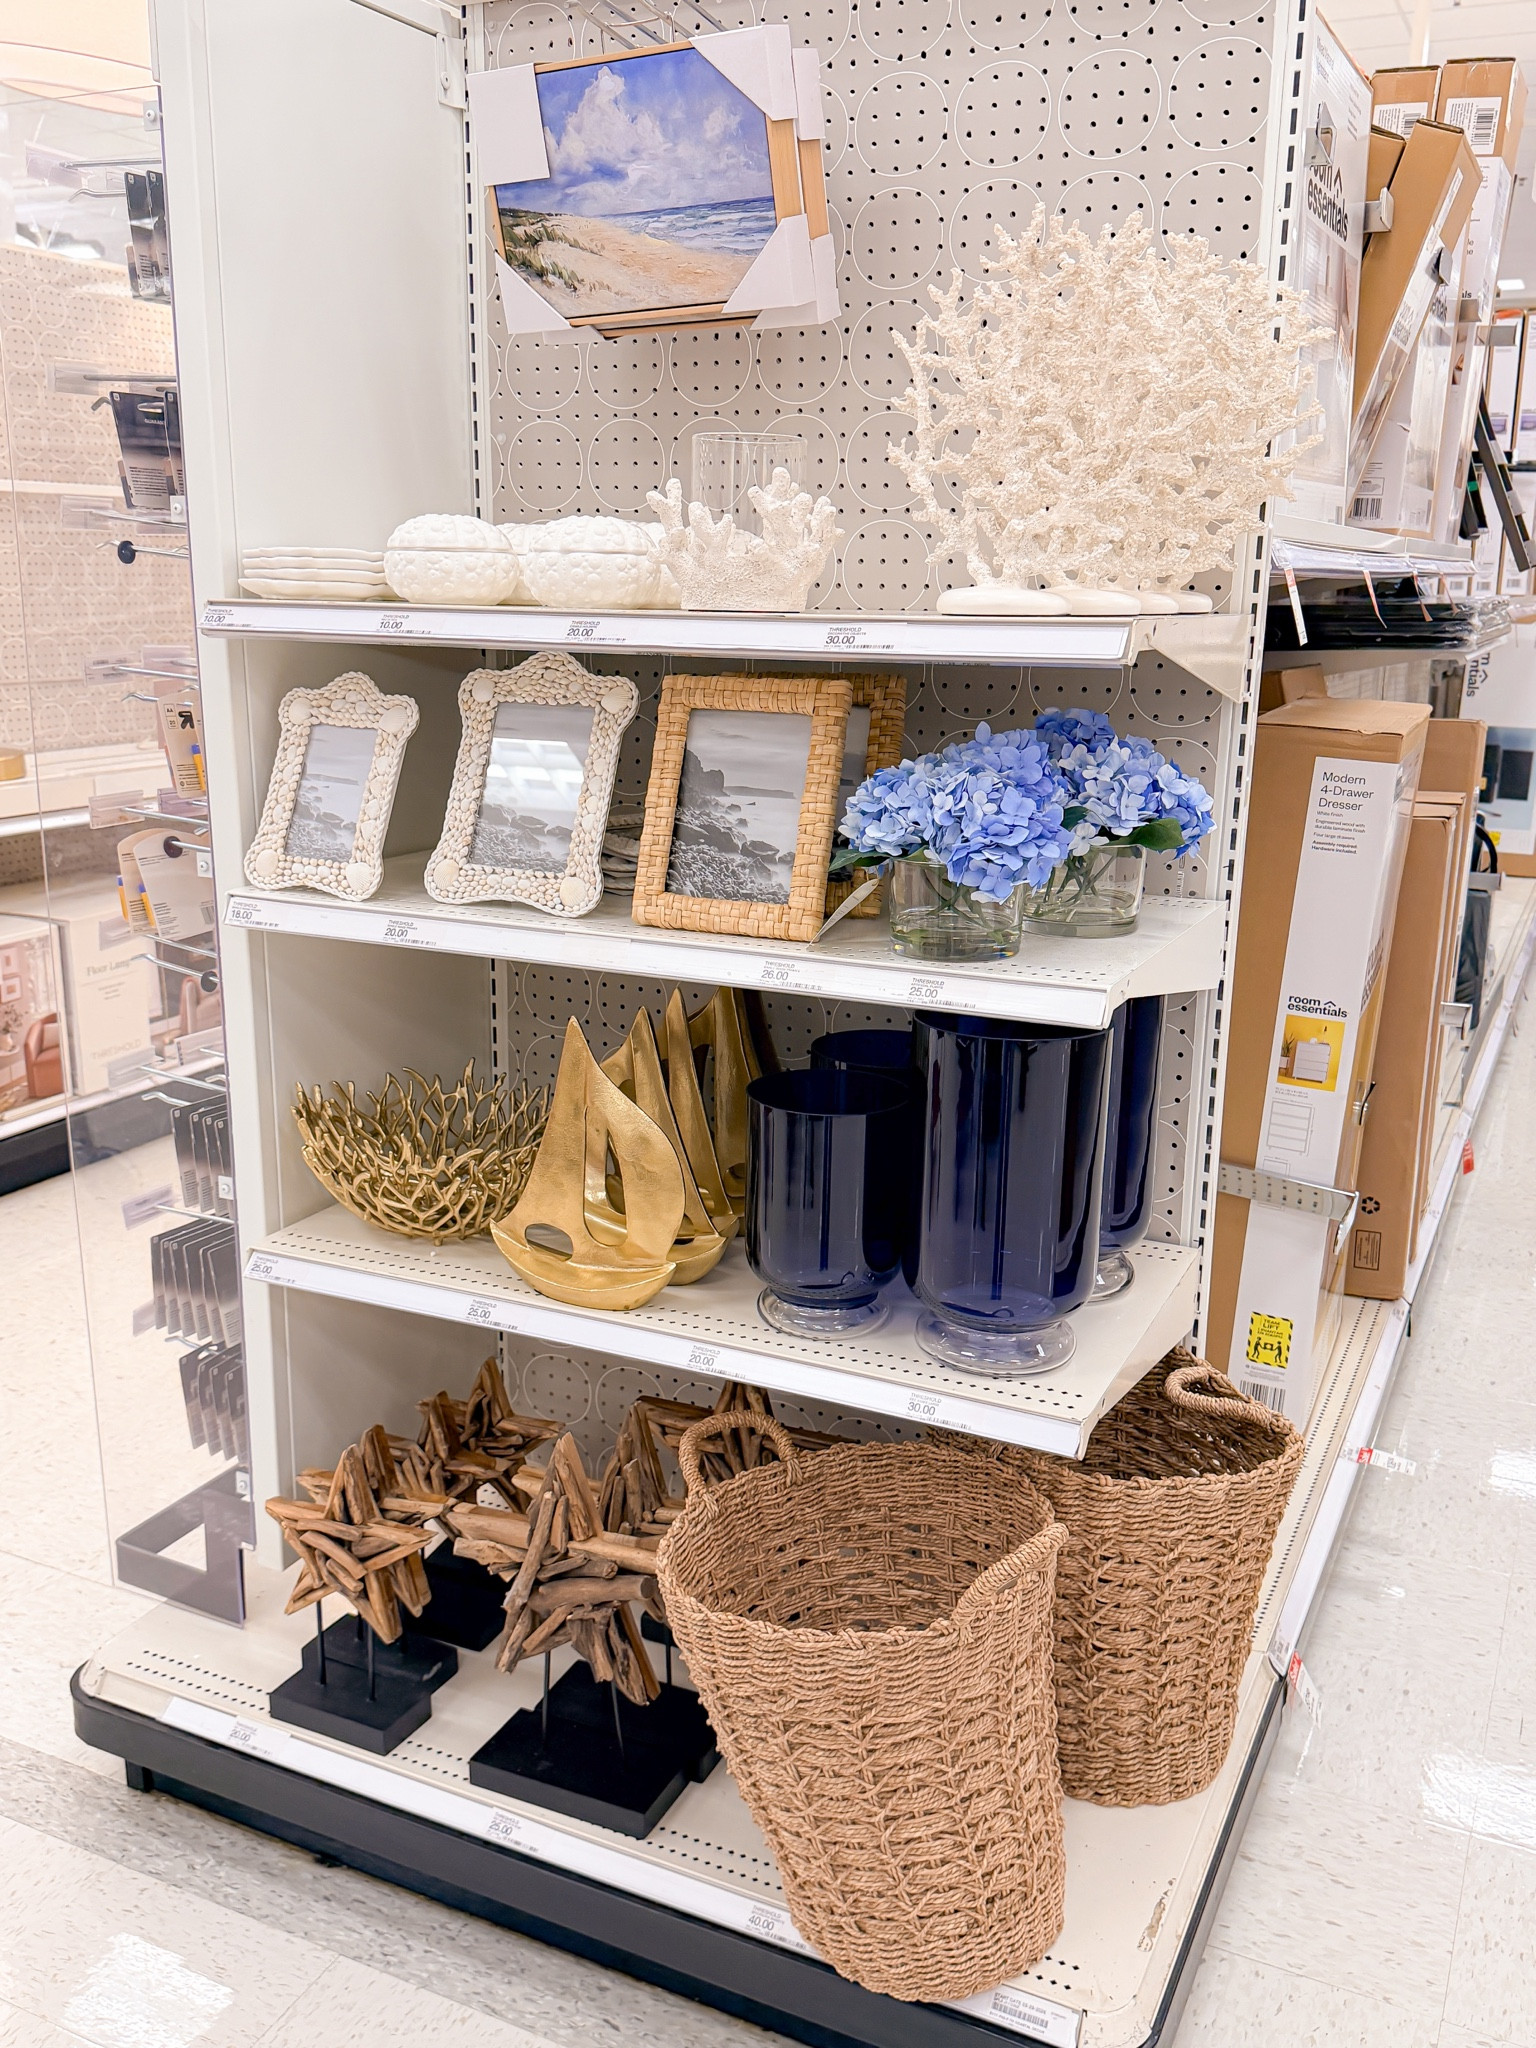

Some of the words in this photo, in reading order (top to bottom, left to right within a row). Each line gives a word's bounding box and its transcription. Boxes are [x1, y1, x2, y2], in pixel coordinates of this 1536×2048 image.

[1308, 178, 1348, 242] essentials
[204, 615, 226, 623] 10.00
[380, 621, 403, 629] 10.00
[567, 628, 594, 637] 20.00
[826, 636, 856, 645] 30.00
[1466, 659, 1482, 697] ntials
[1322, 771, 1366, 785] Modern
[1320, 785, 1374, 799] 4-Drawer
[1318, 797, 1363, 811] Dresser
[1315, 819, 1341, 827] Engineered
[231, 910, 253, 920] 18.00
[384, 927, 408, 938] 20.00
[765, 960, 795, 968] THRESHOLD
[761, 969, 788, 980] 26.00
[912, 977, 945, 986] THRESHOLD
[909, 986, 938, 998] 25.00
[1288, 995, 1321, 1006] room
[1287, 1003, 1348, 1018] essentials
[251, 1263, 273, 1274] 25.00
[468, 1307, 491, 1319] 25.00
[689, 1354, 715, 1367] 20.00
[911, 1393, 942, 1404] THRESHOLD
[907, 1401, 936, 1416] 30.00
[748, 1915, 774, 1931] 40.00
